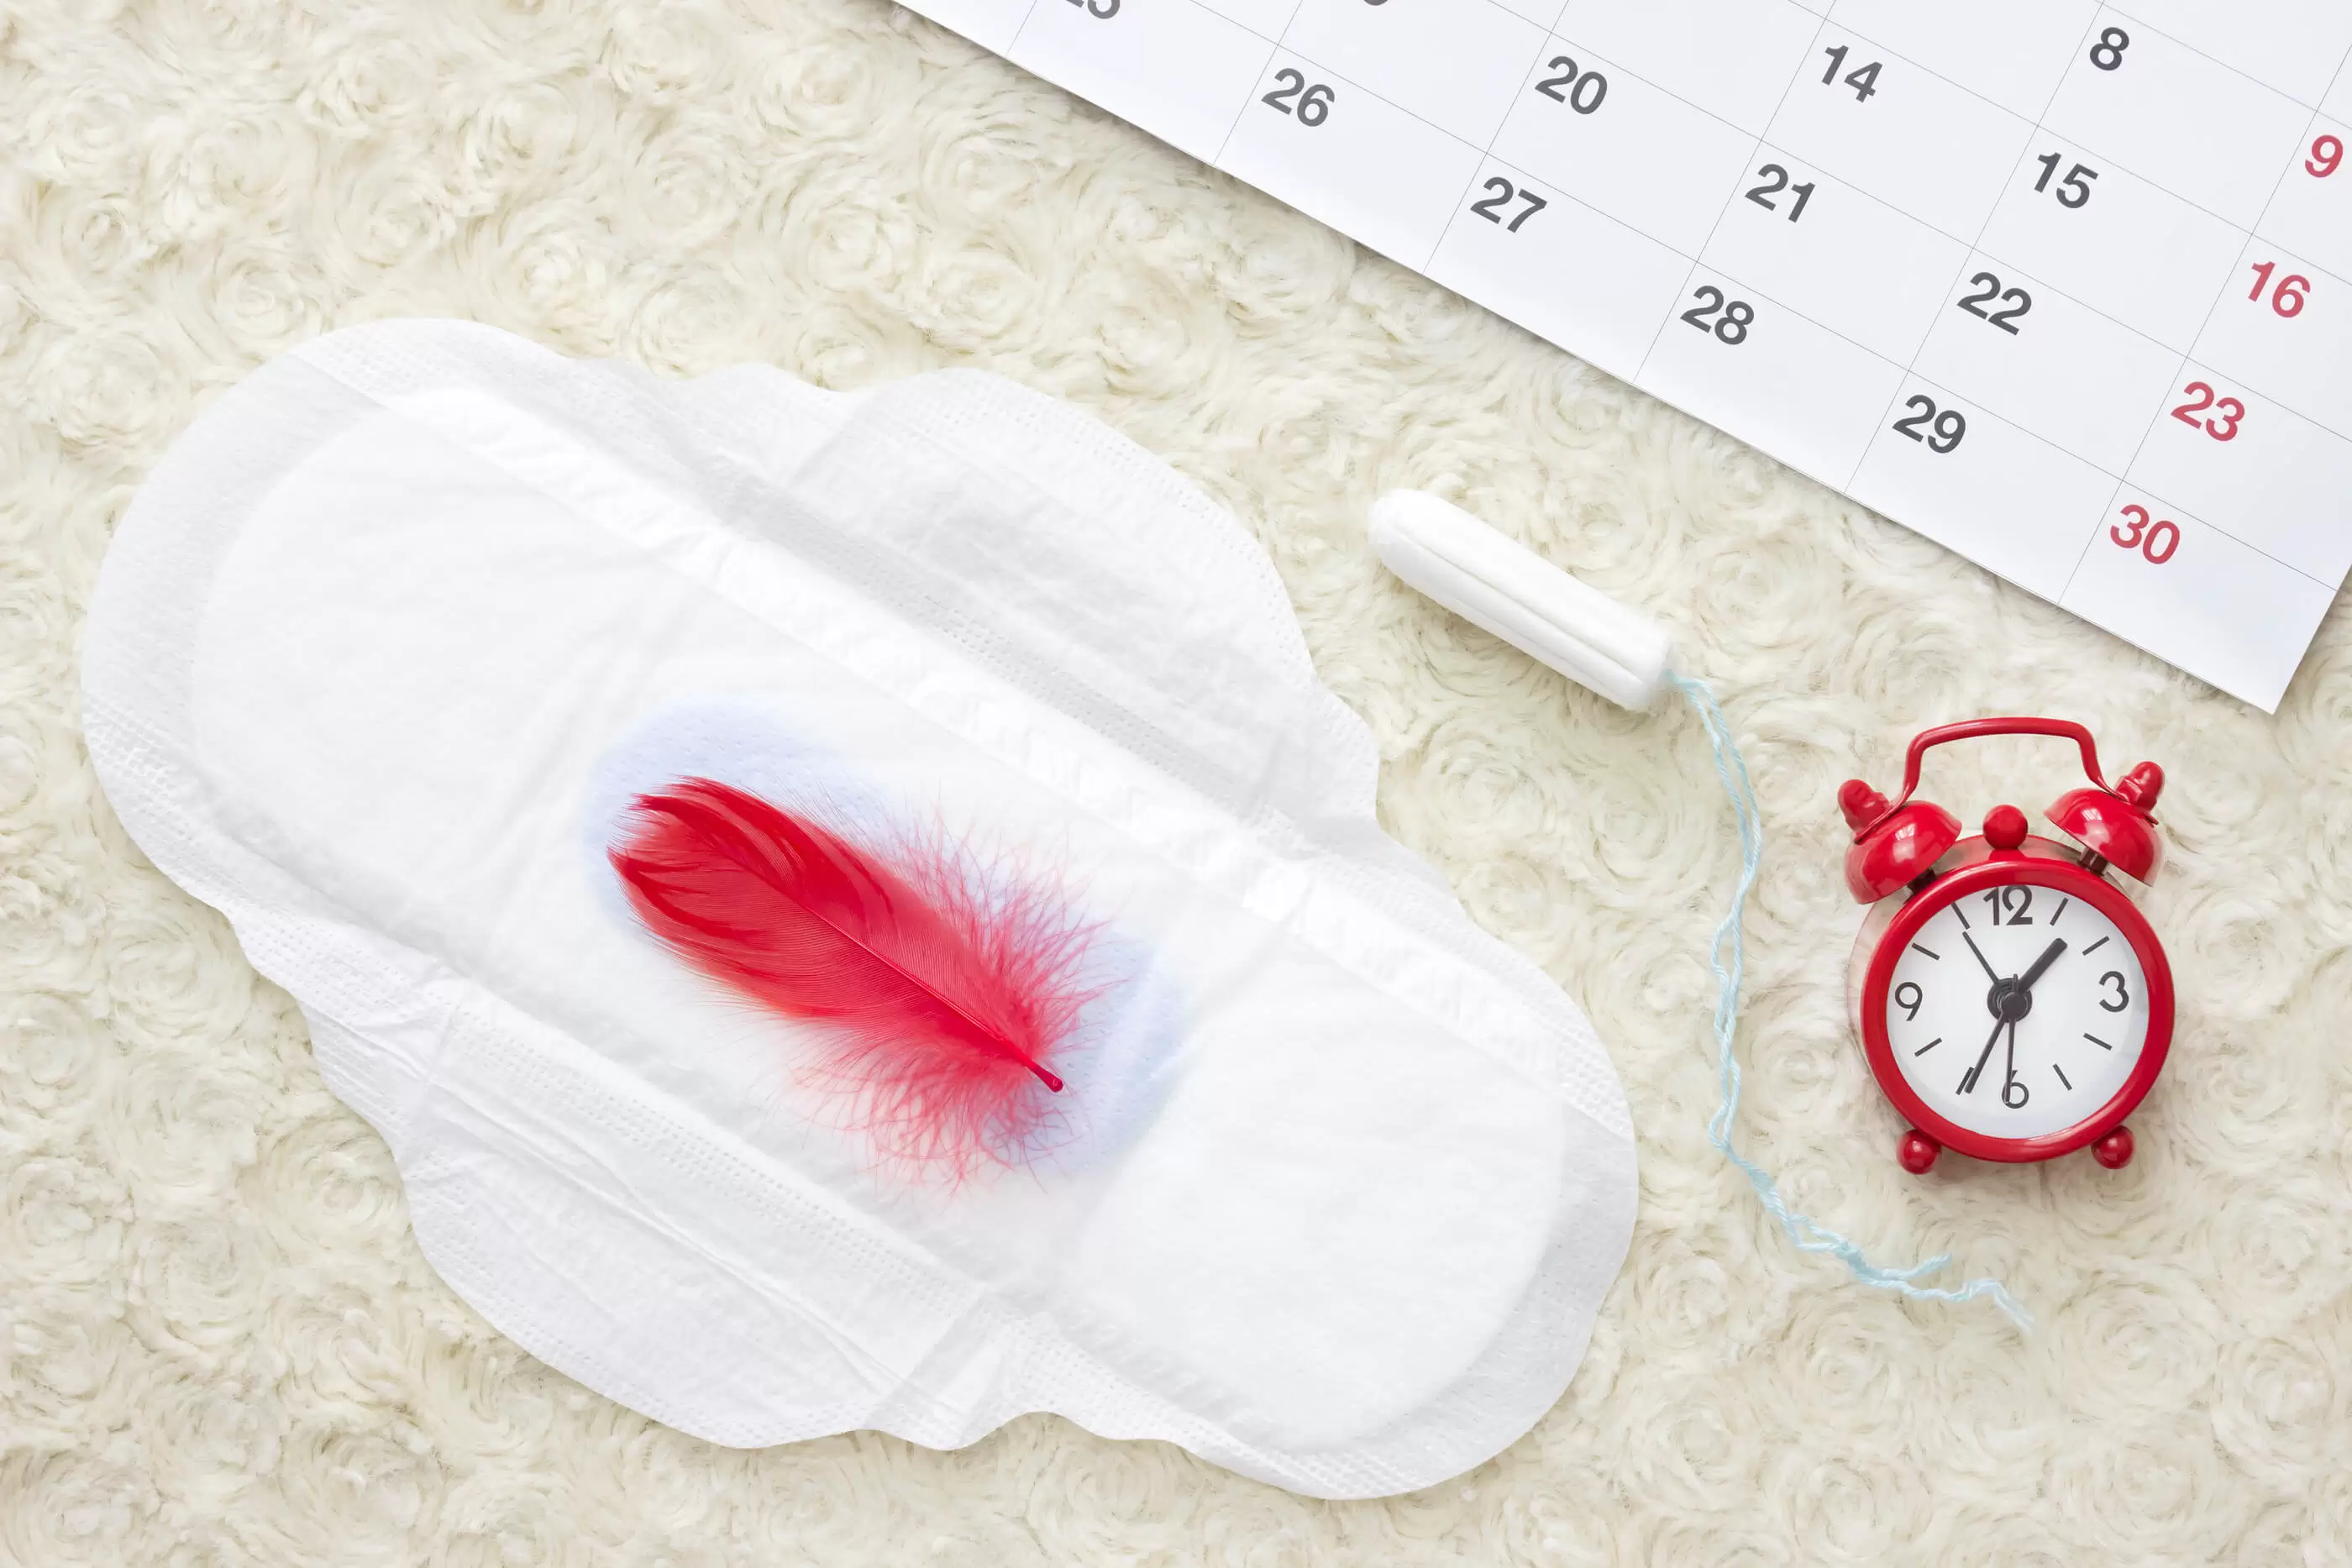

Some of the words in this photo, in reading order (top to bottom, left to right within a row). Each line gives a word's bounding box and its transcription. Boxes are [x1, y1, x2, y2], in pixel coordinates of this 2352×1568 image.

[2090, 27, 2129, 71] 8
[2304, 134, 2344, 178] 9
[1821, 45, 1883, 102] 14
[2034, 151, 2099, 209] 15
[2248, 261, 2311, 318] 16
[1535, 55, 1608, 115] 20
[1745, 164, 1816, 223] 21
[1956, 272, 2032, 336] 22
[2171, 381, 2245, 442] 23
[1261, 68, 1335, 127] 26
[1470, 176, 1547, 233] 27
[1680, 286, 1755, 345] 28
[1892, 395, 1966, 454] 29
[2110, 504, 2181, 564] 30
[1982, 885, 2033, 926] 12
[1894, 981, 1924, 1022] 9
[2098, 970, 2129, 1013] 3
[2001, 1069, 2029, 1109] 6
